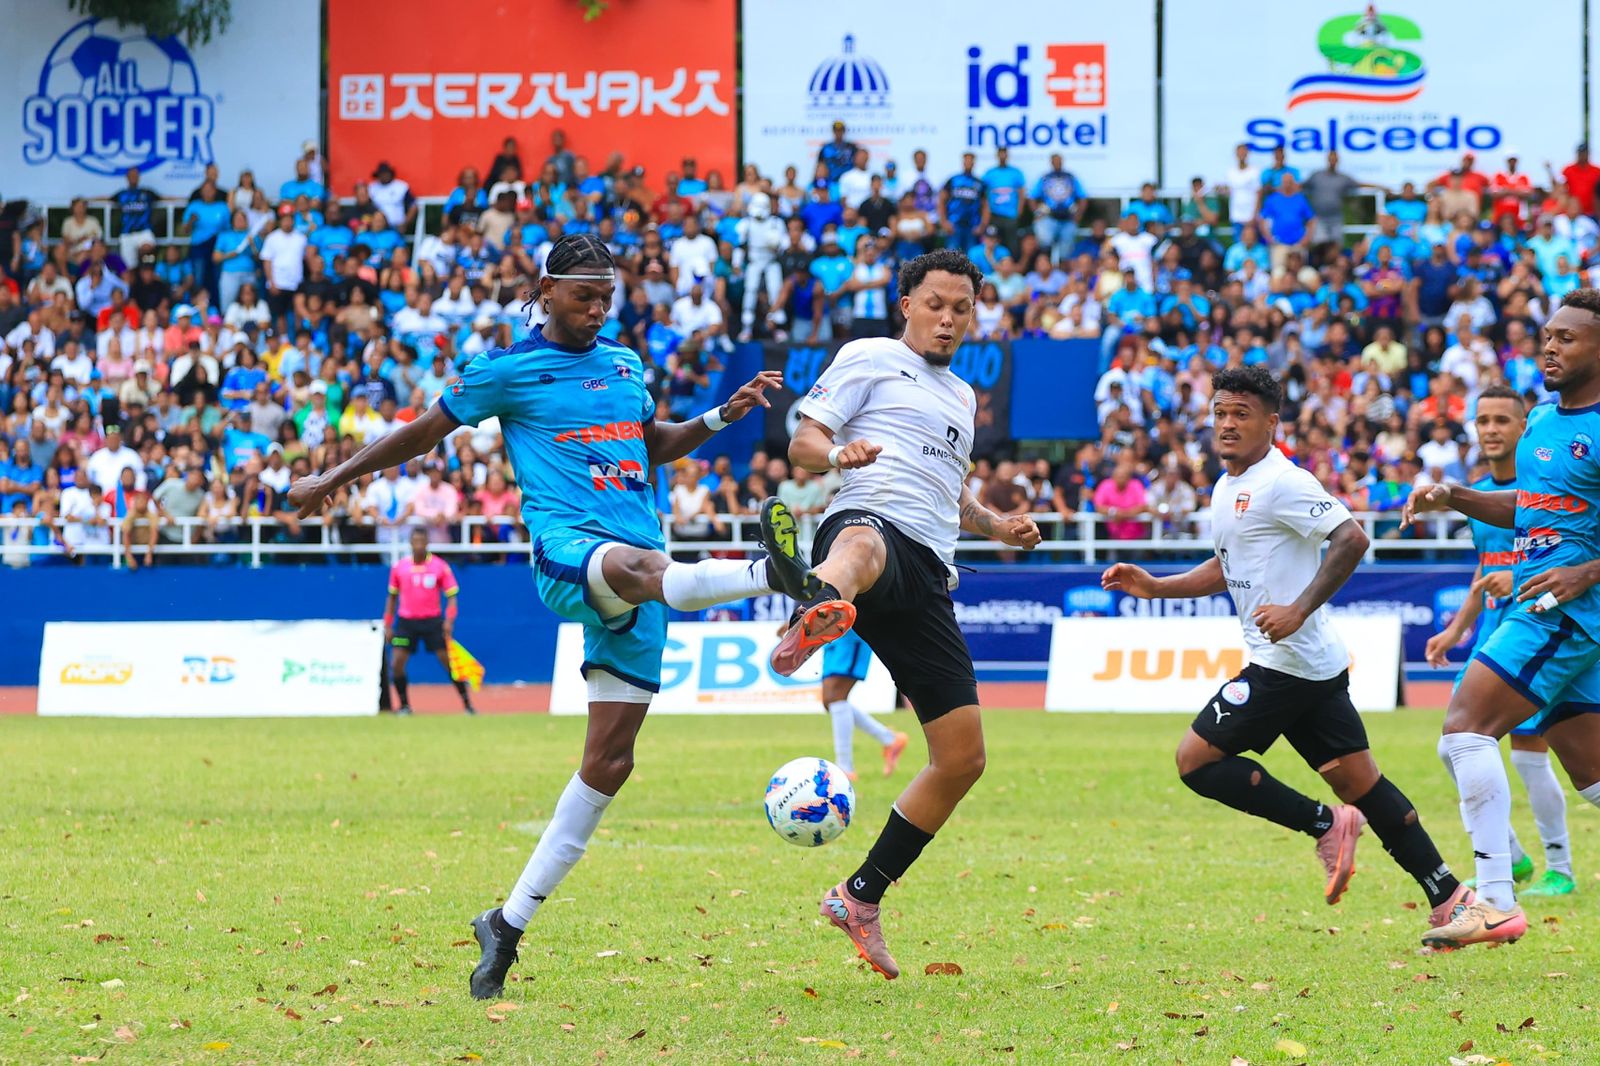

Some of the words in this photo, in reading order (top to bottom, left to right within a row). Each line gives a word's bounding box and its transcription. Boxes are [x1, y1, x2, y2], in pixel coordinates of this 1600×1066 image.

[97, 58, 139, 96] ALL
[966, 44, 1030, 109] id
[24, 95, 214, 164] SOCCER
[966, 114, 1107, 147] indotel
[1245, 117, 1501, 153] Salcedo
[582, 379, 606, 390] GBC
[1092, 648, 1244, 681] JUM
[777, 778, 811, 810] VECTOR
